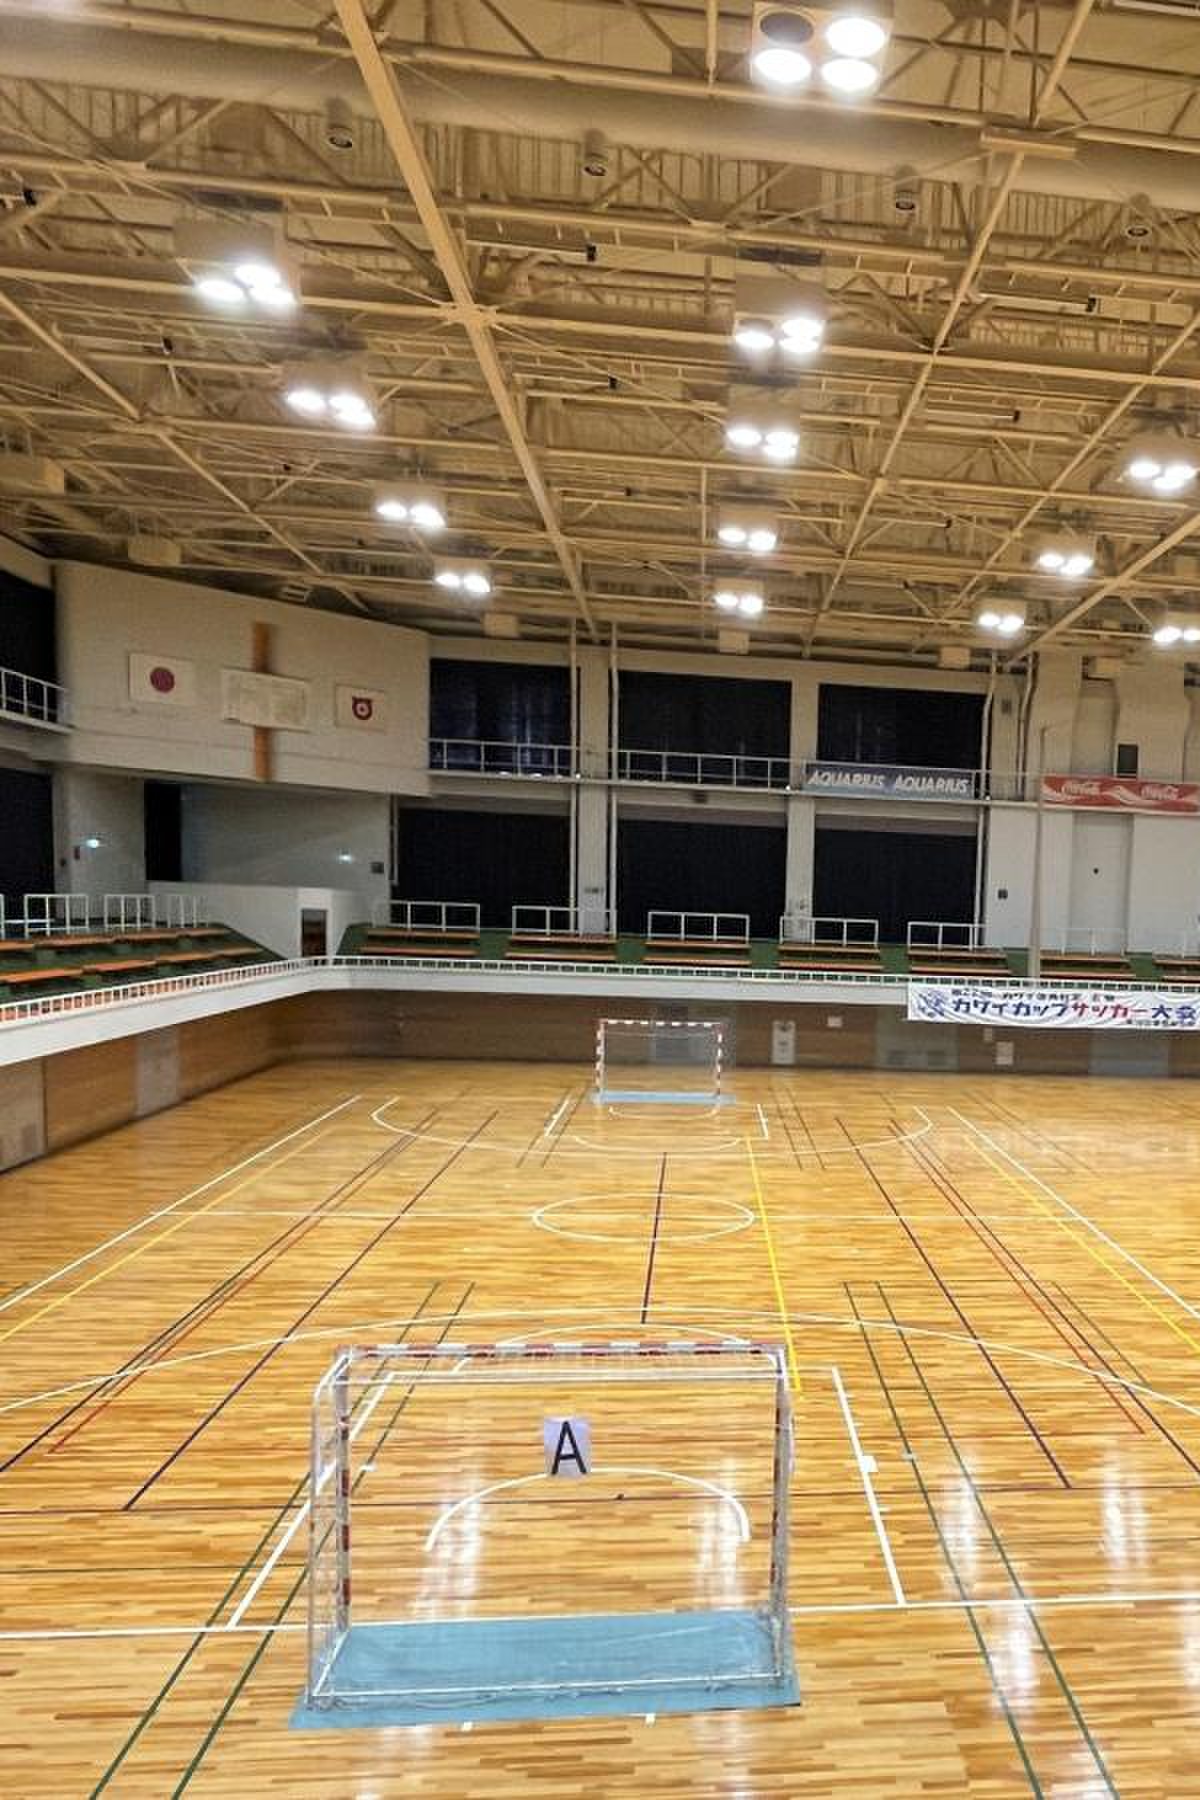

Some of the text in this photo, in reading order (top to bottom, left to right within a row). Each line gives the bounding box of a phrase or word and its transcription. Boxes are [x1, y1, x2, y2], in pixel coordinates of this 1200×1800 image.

[808, 770, 969, 793] AQUARIUS AQUARIUS
[552, 1421, 586, 1474] A
